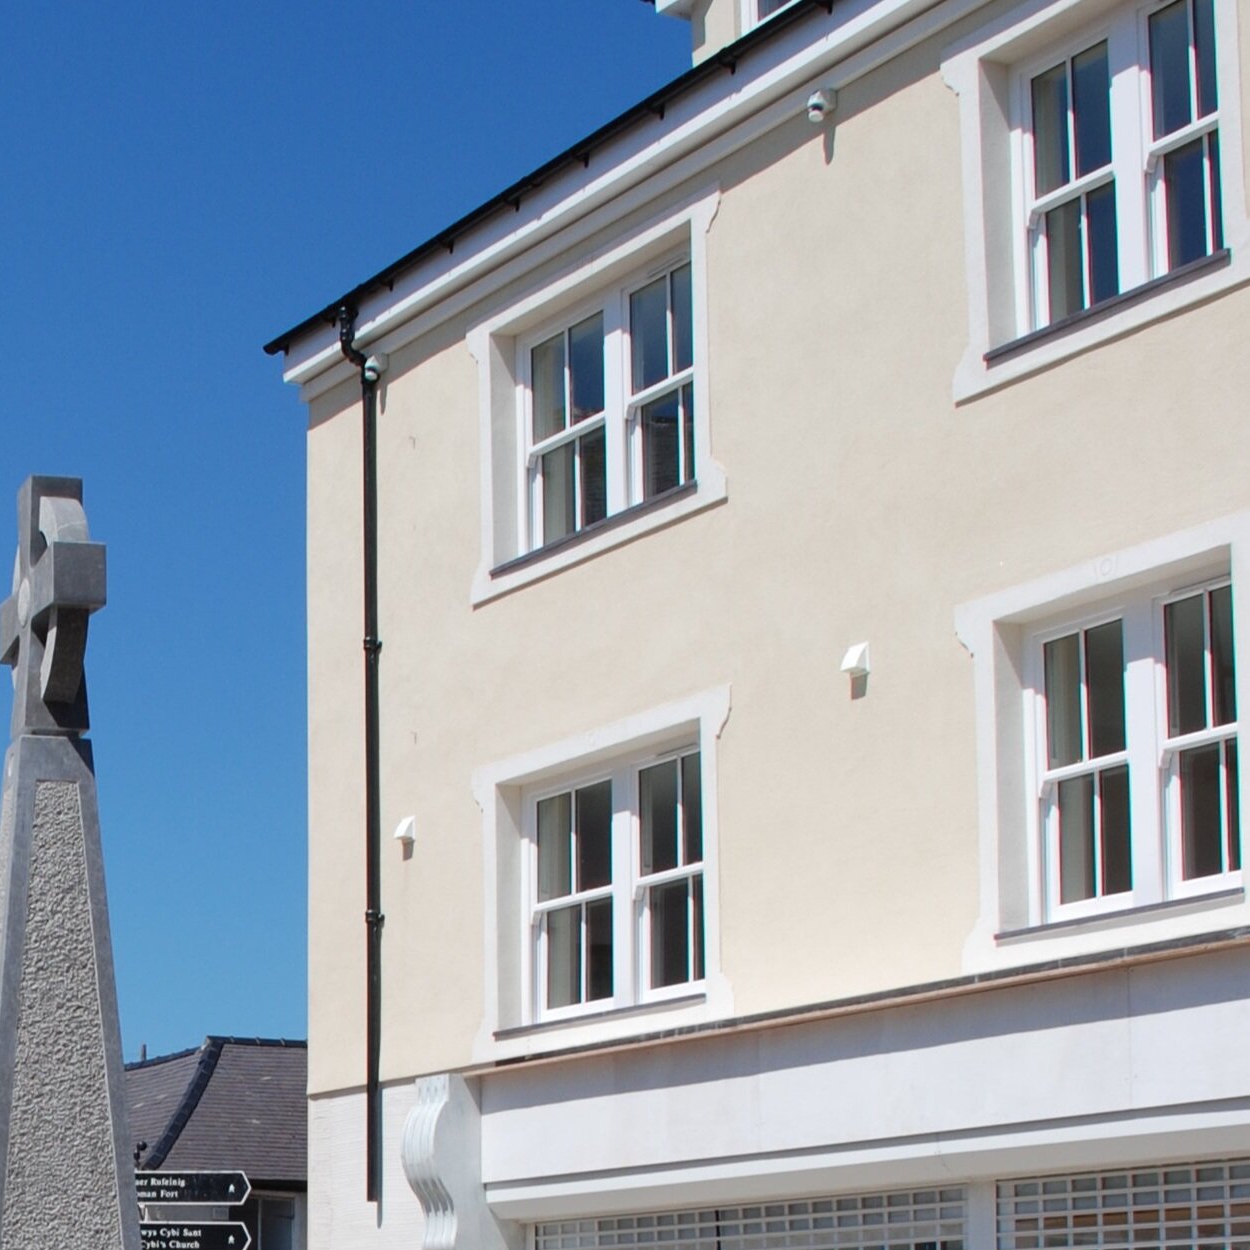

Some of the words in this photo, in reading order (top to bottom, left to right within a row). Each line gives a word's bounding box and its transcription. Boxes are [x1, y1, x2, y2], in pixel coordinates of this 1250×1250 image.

[160, 1190, 179, 1198] Fort
[159, 1228, 180, 1238] Cybi
[183, 1228, 202, 1237] Sant
[169, 1240, 200, 1249] Church
